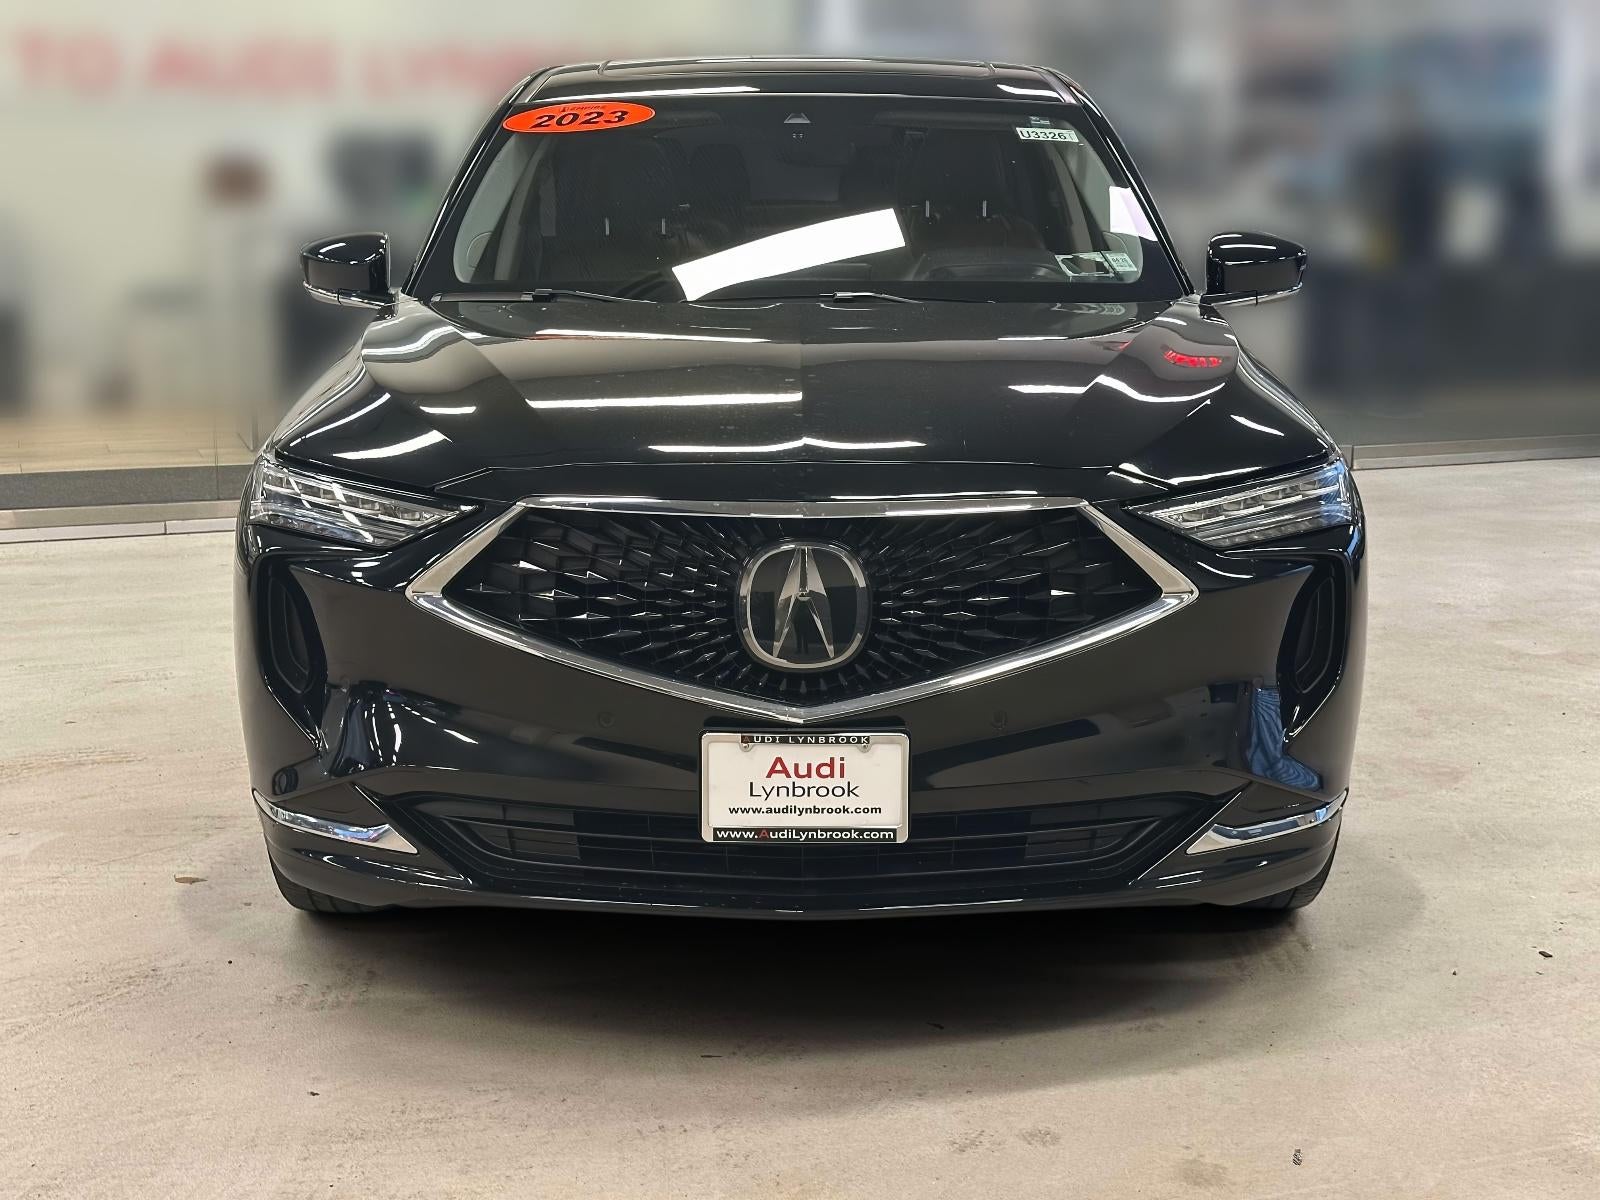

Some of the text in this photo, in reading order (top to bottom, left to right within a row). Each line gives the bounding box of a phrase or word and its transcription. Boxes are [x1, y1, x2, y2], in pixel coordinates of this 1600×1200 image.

[530, 110, 629, 129] 2023
[743, 735, 869, 744] AUDI LYNBROOK
[765, 756, 846, 779] Audi
[749, 781, 860, 801] Lynbrook
[728, 805, 882, 816] www.audilynbrook.com
[716, 828, 894, 841] www.AudiLynbrook.com
